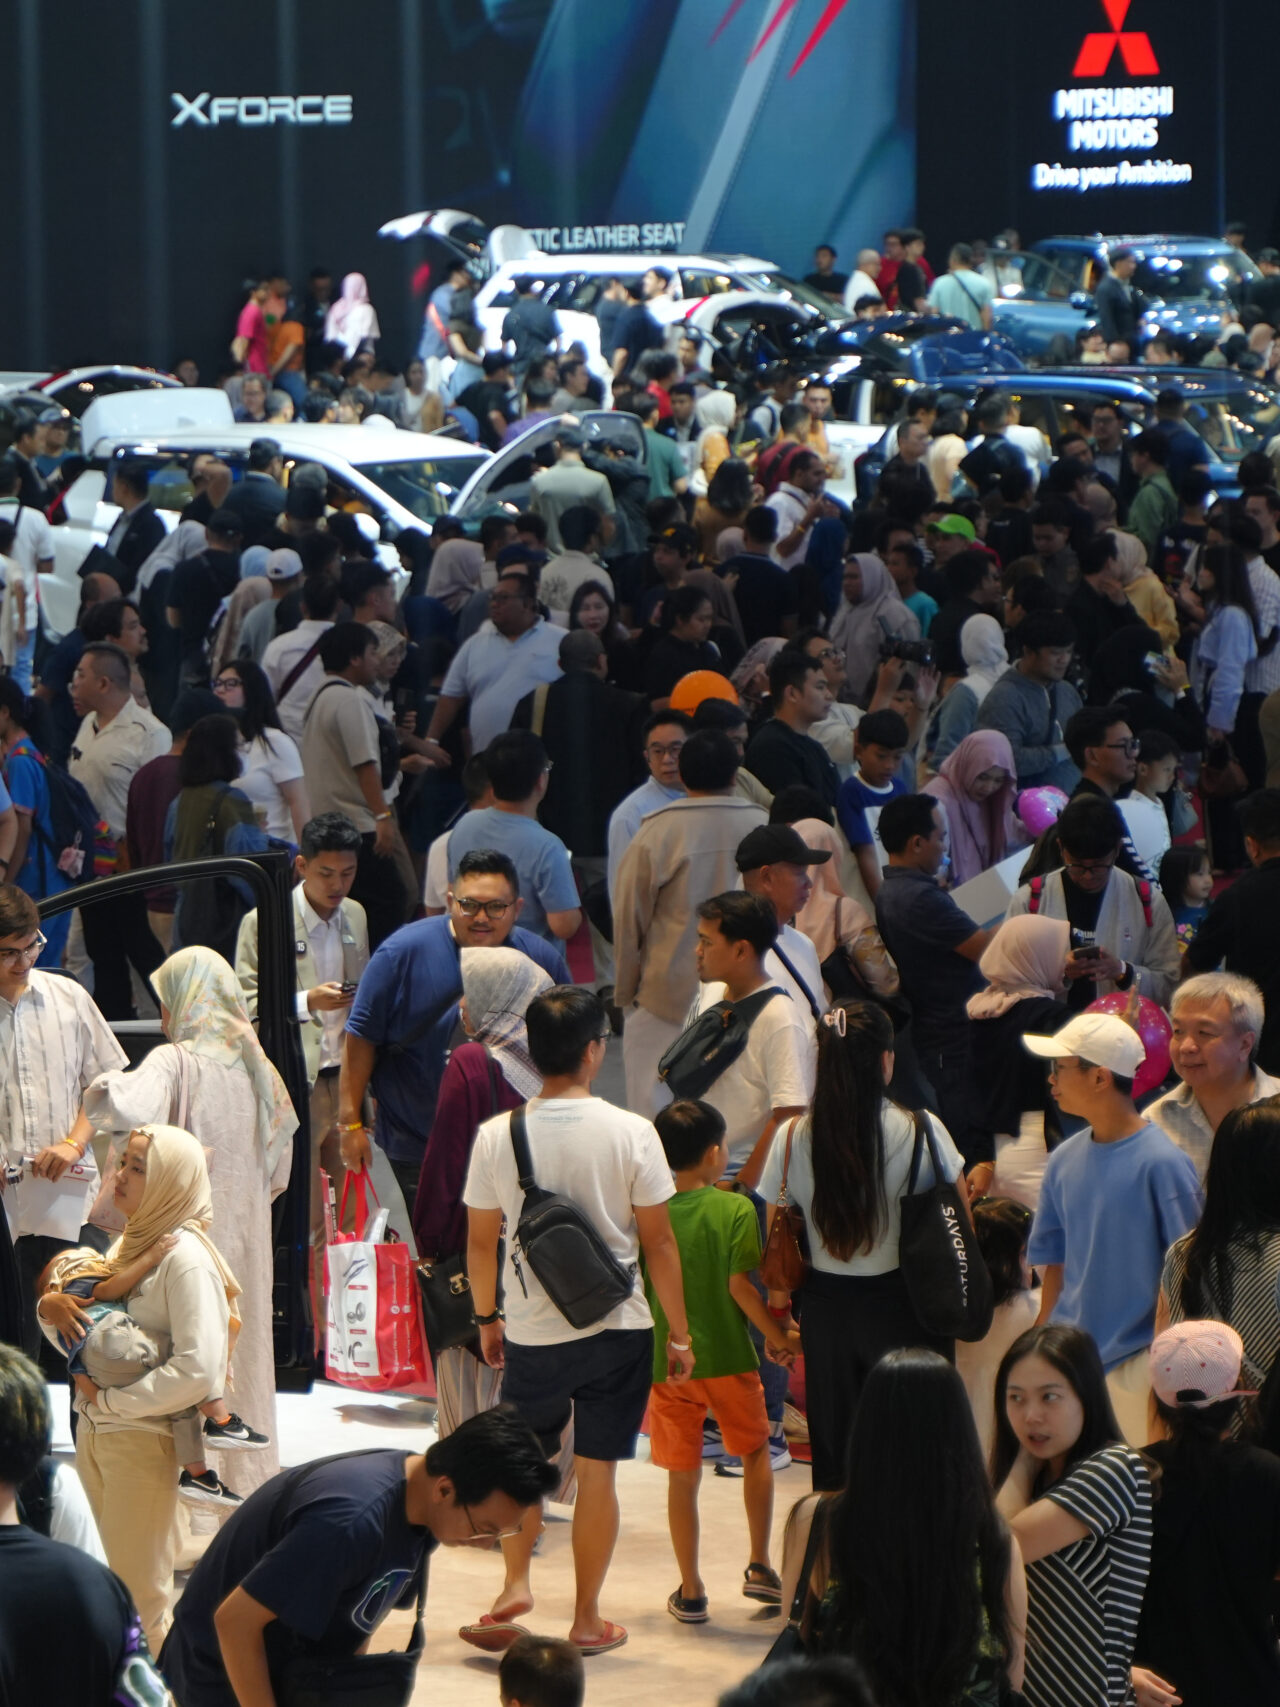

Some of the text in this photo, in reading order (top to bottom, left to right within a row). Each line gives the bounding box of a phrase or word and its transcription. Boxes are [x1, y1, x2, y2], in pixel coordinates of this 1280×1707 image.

[171, 92, 353, 125] XFORCE
[1054, 86, 1174, 120] MITSUBISHI
[1070, 118, 1159, 150] MOTORS
[1033, 159, 1193, 192] Drive your Ambition
[562, 224, 640, 249] LEATHER
[641, 222, 686, 244] SEAT
